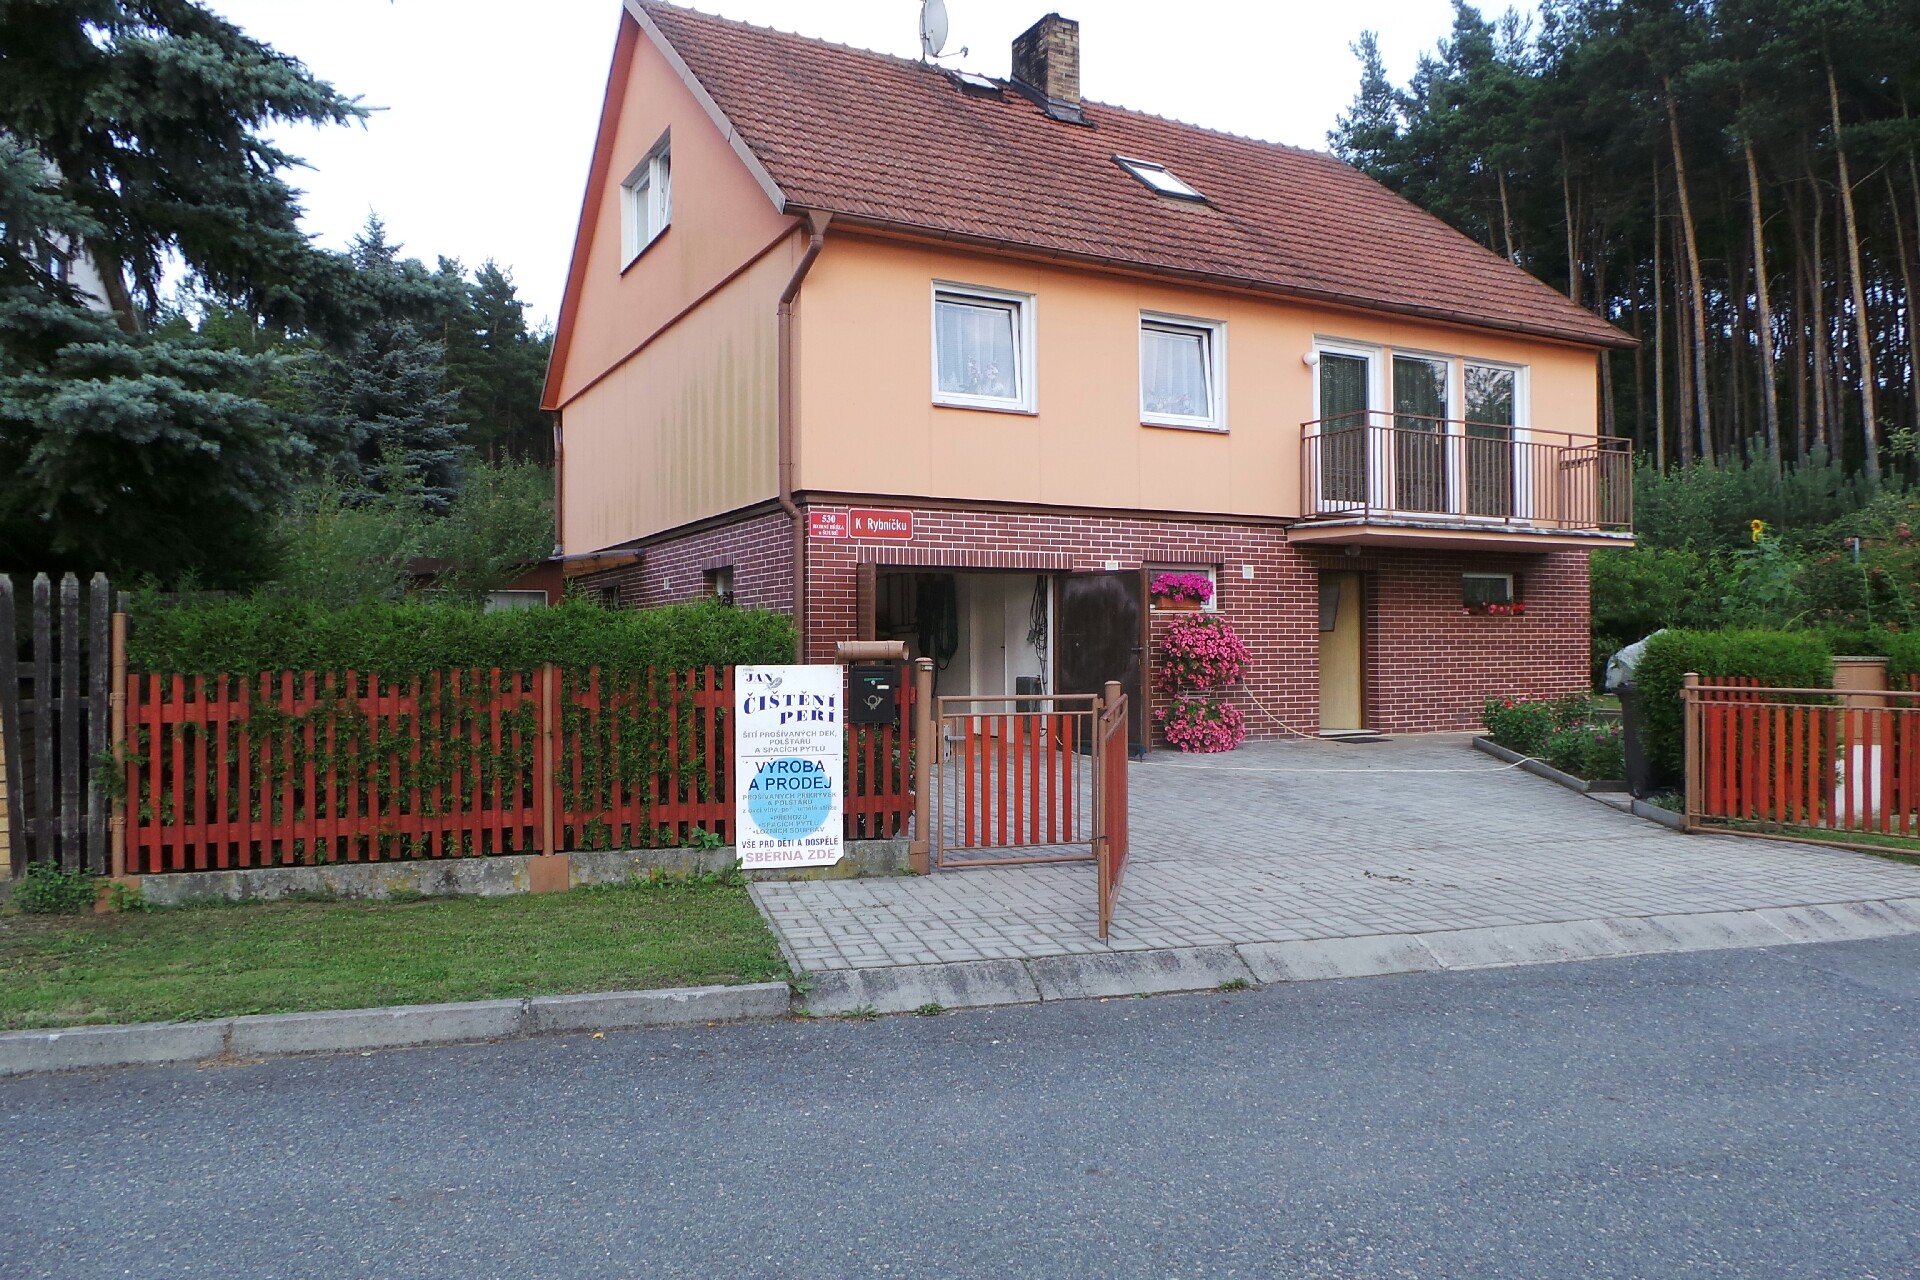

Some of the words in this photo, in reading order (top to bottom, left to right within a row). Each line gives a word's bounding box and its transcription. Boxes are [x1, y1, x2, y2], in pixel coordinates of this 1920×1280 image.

[822, 515, 836, 523] 530
[856, 517, 862, 529] K
[868, 518, 907, 532] Rybníčku
[746, 673, 773, 682] JAN
[744, 690, 835, 714] ČIŠTĚNÍ
[780, 706, 835, 725] PEŘÍ
[743, 730, 757, 738] ŠITÍ
[760, 730, 816, 738] PROŠÍVANÝCH
[819, 730, 837, 738] DEK,
[769, 737, 811, 745] POLŠTÁŘŮ
[800, 744, 826, 752] PYTLŮ
[755, 757, 825, 773] VÝROBA
[749, 778, 759, 791] A
[766, 776, 831, 790] PRODEJ
[789, 826, 825, 834] SOUPRAV
[741, 838, 756, 849] VŠE
[759, 839, 775, 848] PRO
[777, 837, 795, 848] DĚTI
[797, 839, 802, 847] A
[805, 835, 839, 846] DOSPĚLÉ
[745, 848, 803, 863] SBĚRNA
[807, 848, 836, 860] ZDE
